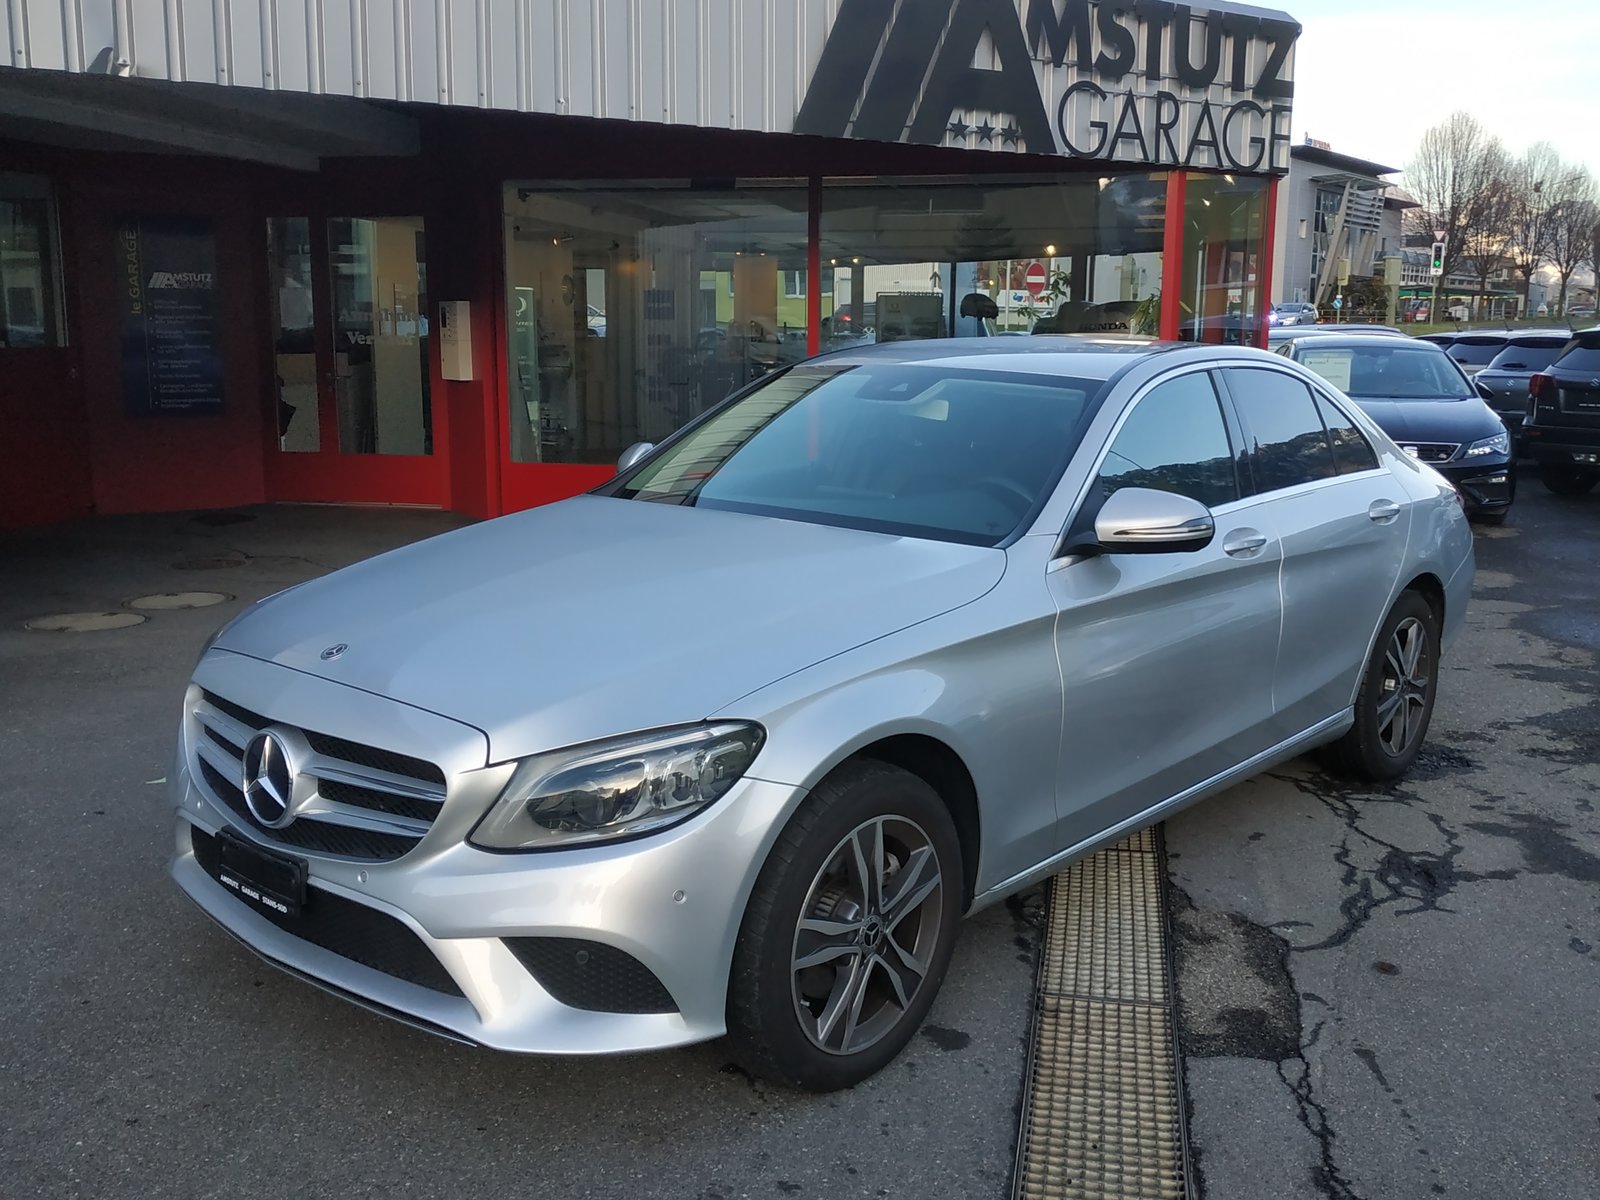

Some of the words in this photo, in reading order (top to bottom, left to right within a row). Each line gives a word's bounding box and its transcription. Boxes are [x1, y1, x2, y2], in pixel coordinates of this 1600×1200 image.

[906, 0, 1302, 153] AMSTUTZ
[1057, 81, 1292, 174] GARAGE
[126, 230, 140, 298] GARAGE
[154, 272, 212, 289] AMSTUTZ
